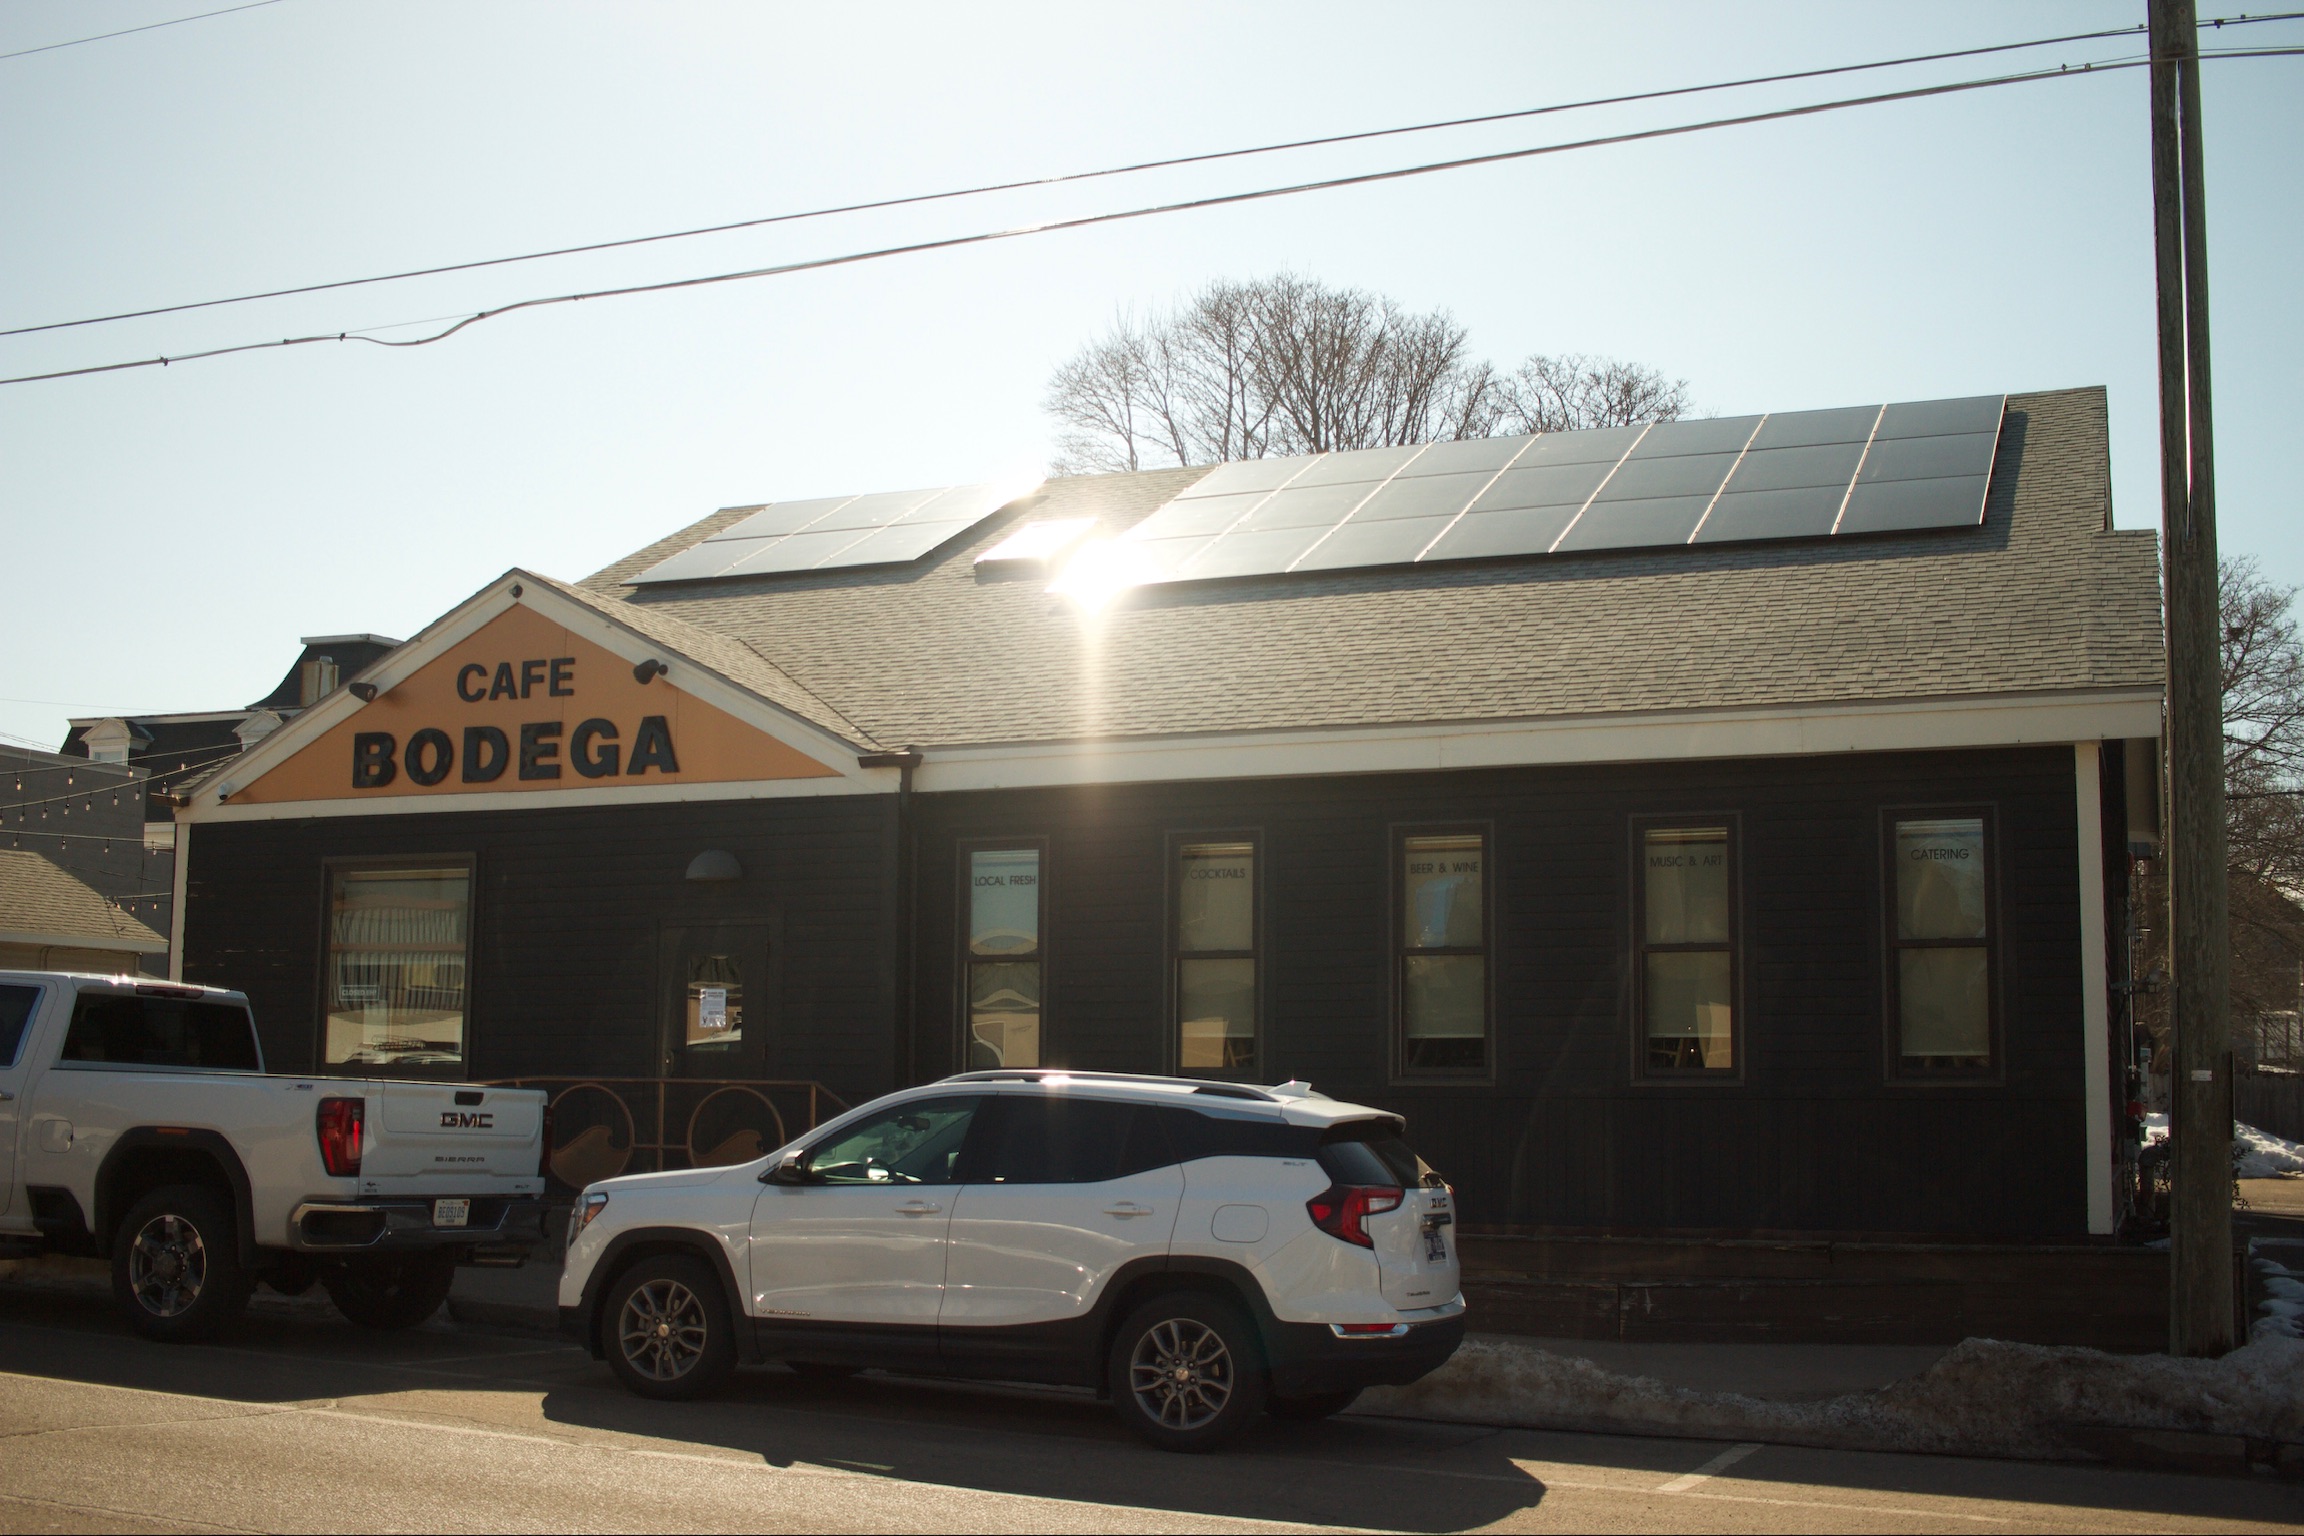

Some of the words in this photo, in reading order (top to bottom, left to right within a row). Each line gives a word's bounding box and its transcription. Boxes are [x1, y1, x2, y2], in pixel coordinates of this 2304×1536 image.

[457, 657, 575, 703] CAFE
[353, 716, 679, 789] BODEGA
[1911, 848, 1969, 860] CATERING
[1410, 862, 1433, 874] BEER
[1438, 862, 1447, 873] &
[1452, 861, 1479, 873] WINE
[1650, 856, 1683, 868] MUSIC
[1688, 856, 1697, 867] &
[1702, 855, 1723, 866] ART
[974, 875, 1005, 887] LOCAL
[1009, 874, 1036, 886] FRESH
[1190, 868, 1246, 880] COCKTAILS
[440, 1112, 493, 1128] GMC
